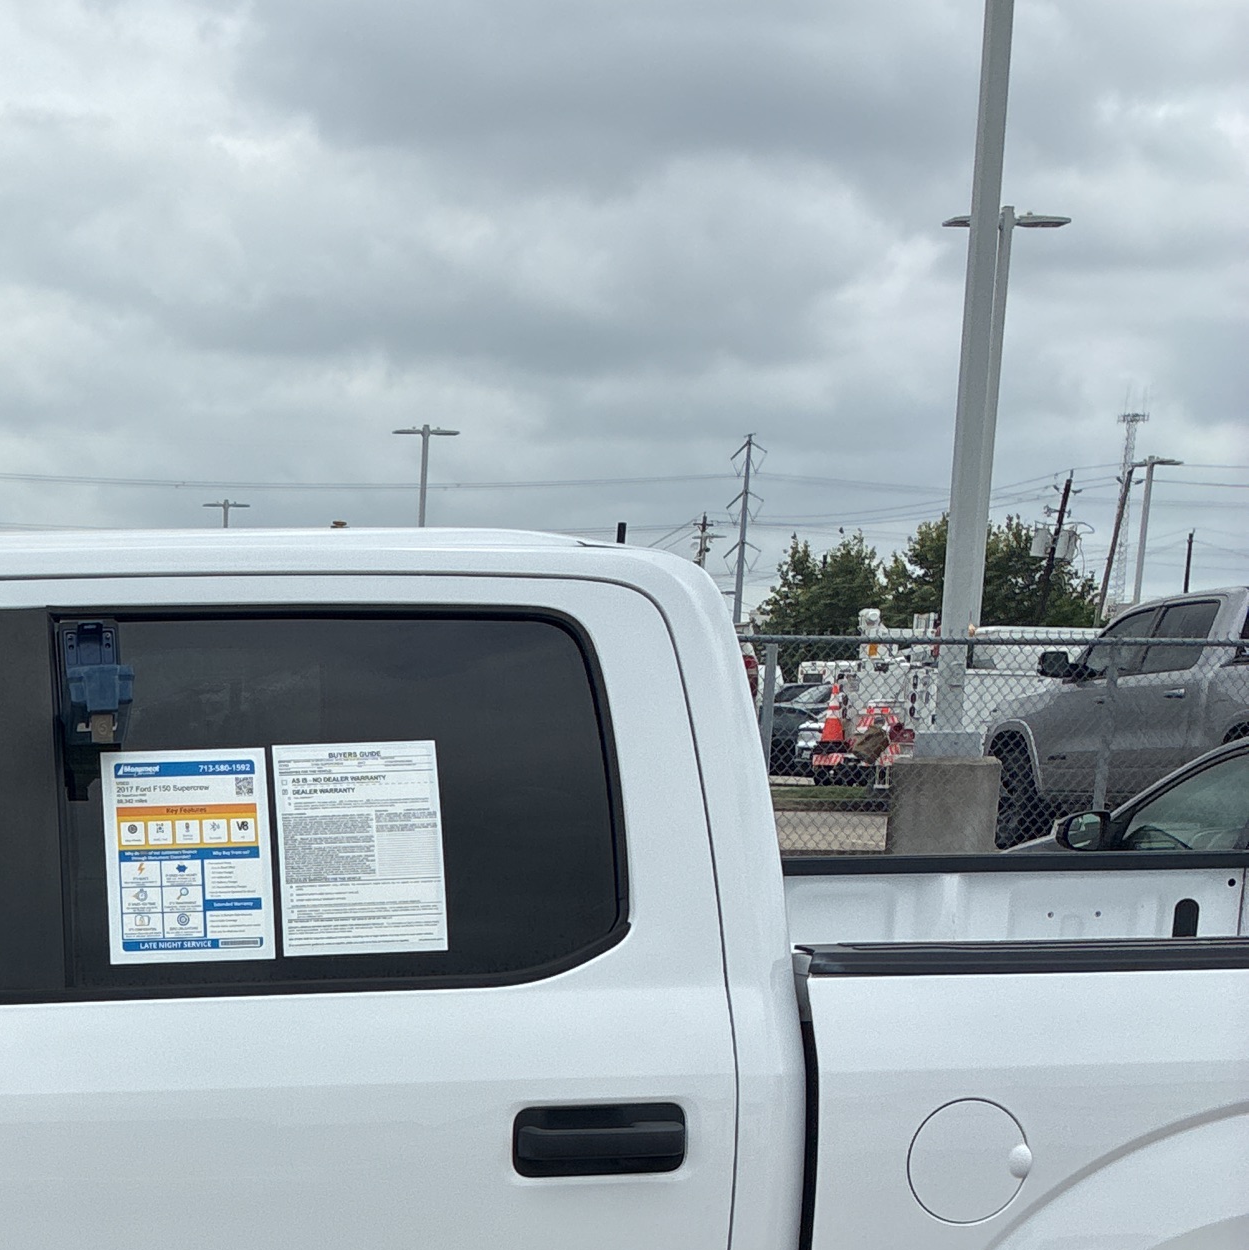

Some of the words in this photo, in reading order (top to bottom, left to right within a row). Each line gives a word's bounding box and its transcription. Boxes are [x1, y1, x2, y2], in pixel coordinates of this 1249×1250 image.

[199, 763, 250, 773] 713-580-1592
[136, 785, 151, 793] Ford
[173, 784, 209, 792] Supercrew
[166, 807, 178, 815] Key
[236, 820, 249, 831] V8
